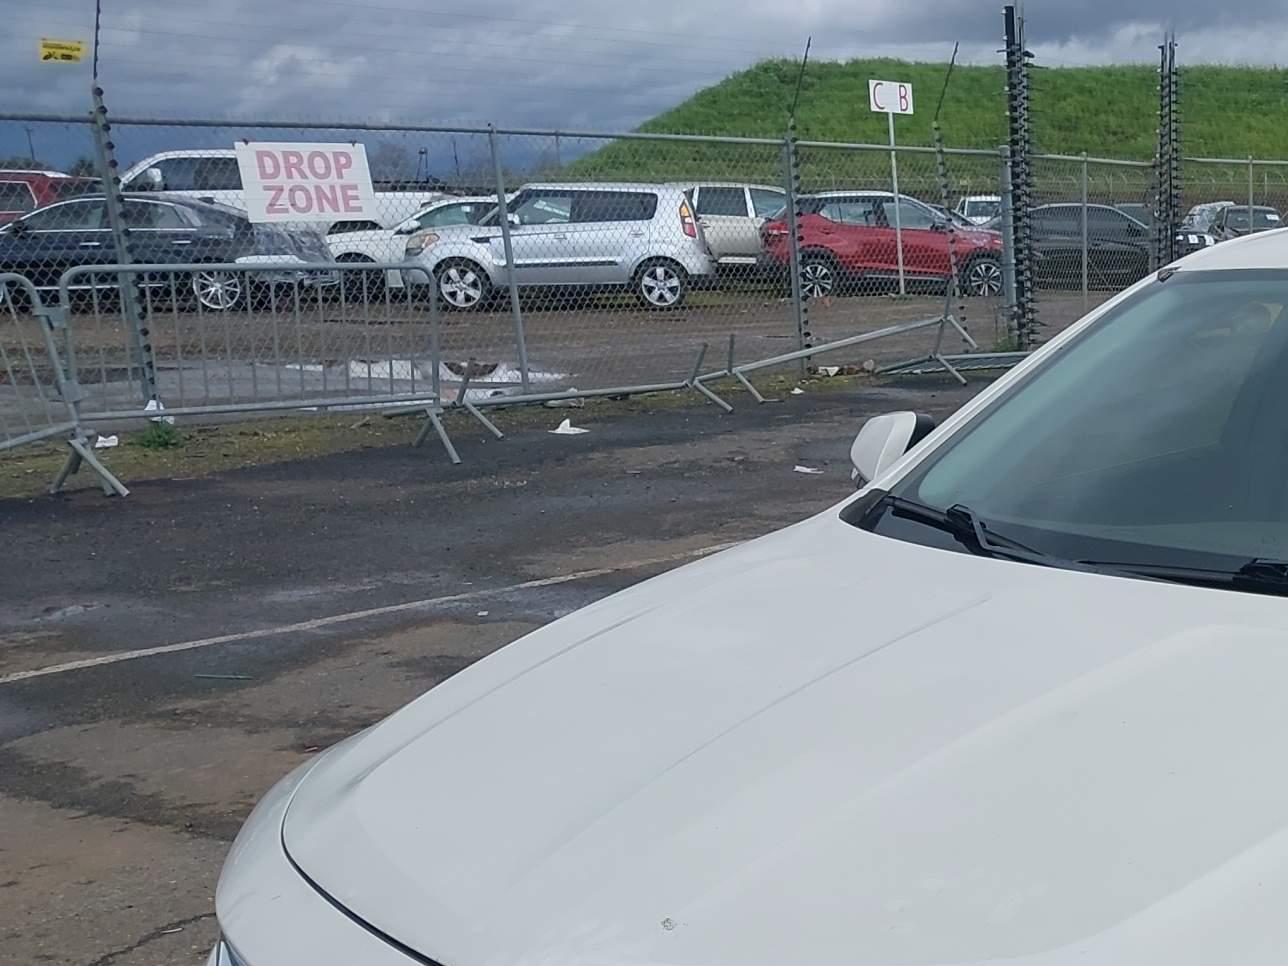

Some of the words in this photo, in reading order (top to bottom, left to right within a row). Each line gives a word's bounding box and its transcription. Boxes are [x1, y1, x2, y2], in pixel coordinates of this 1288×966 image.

[873, 82, 886, 110] C
[898, 84, 909, 112] B
[255, 149, 353, 180] DROP
[262, 184, 363, 214] ZONE
